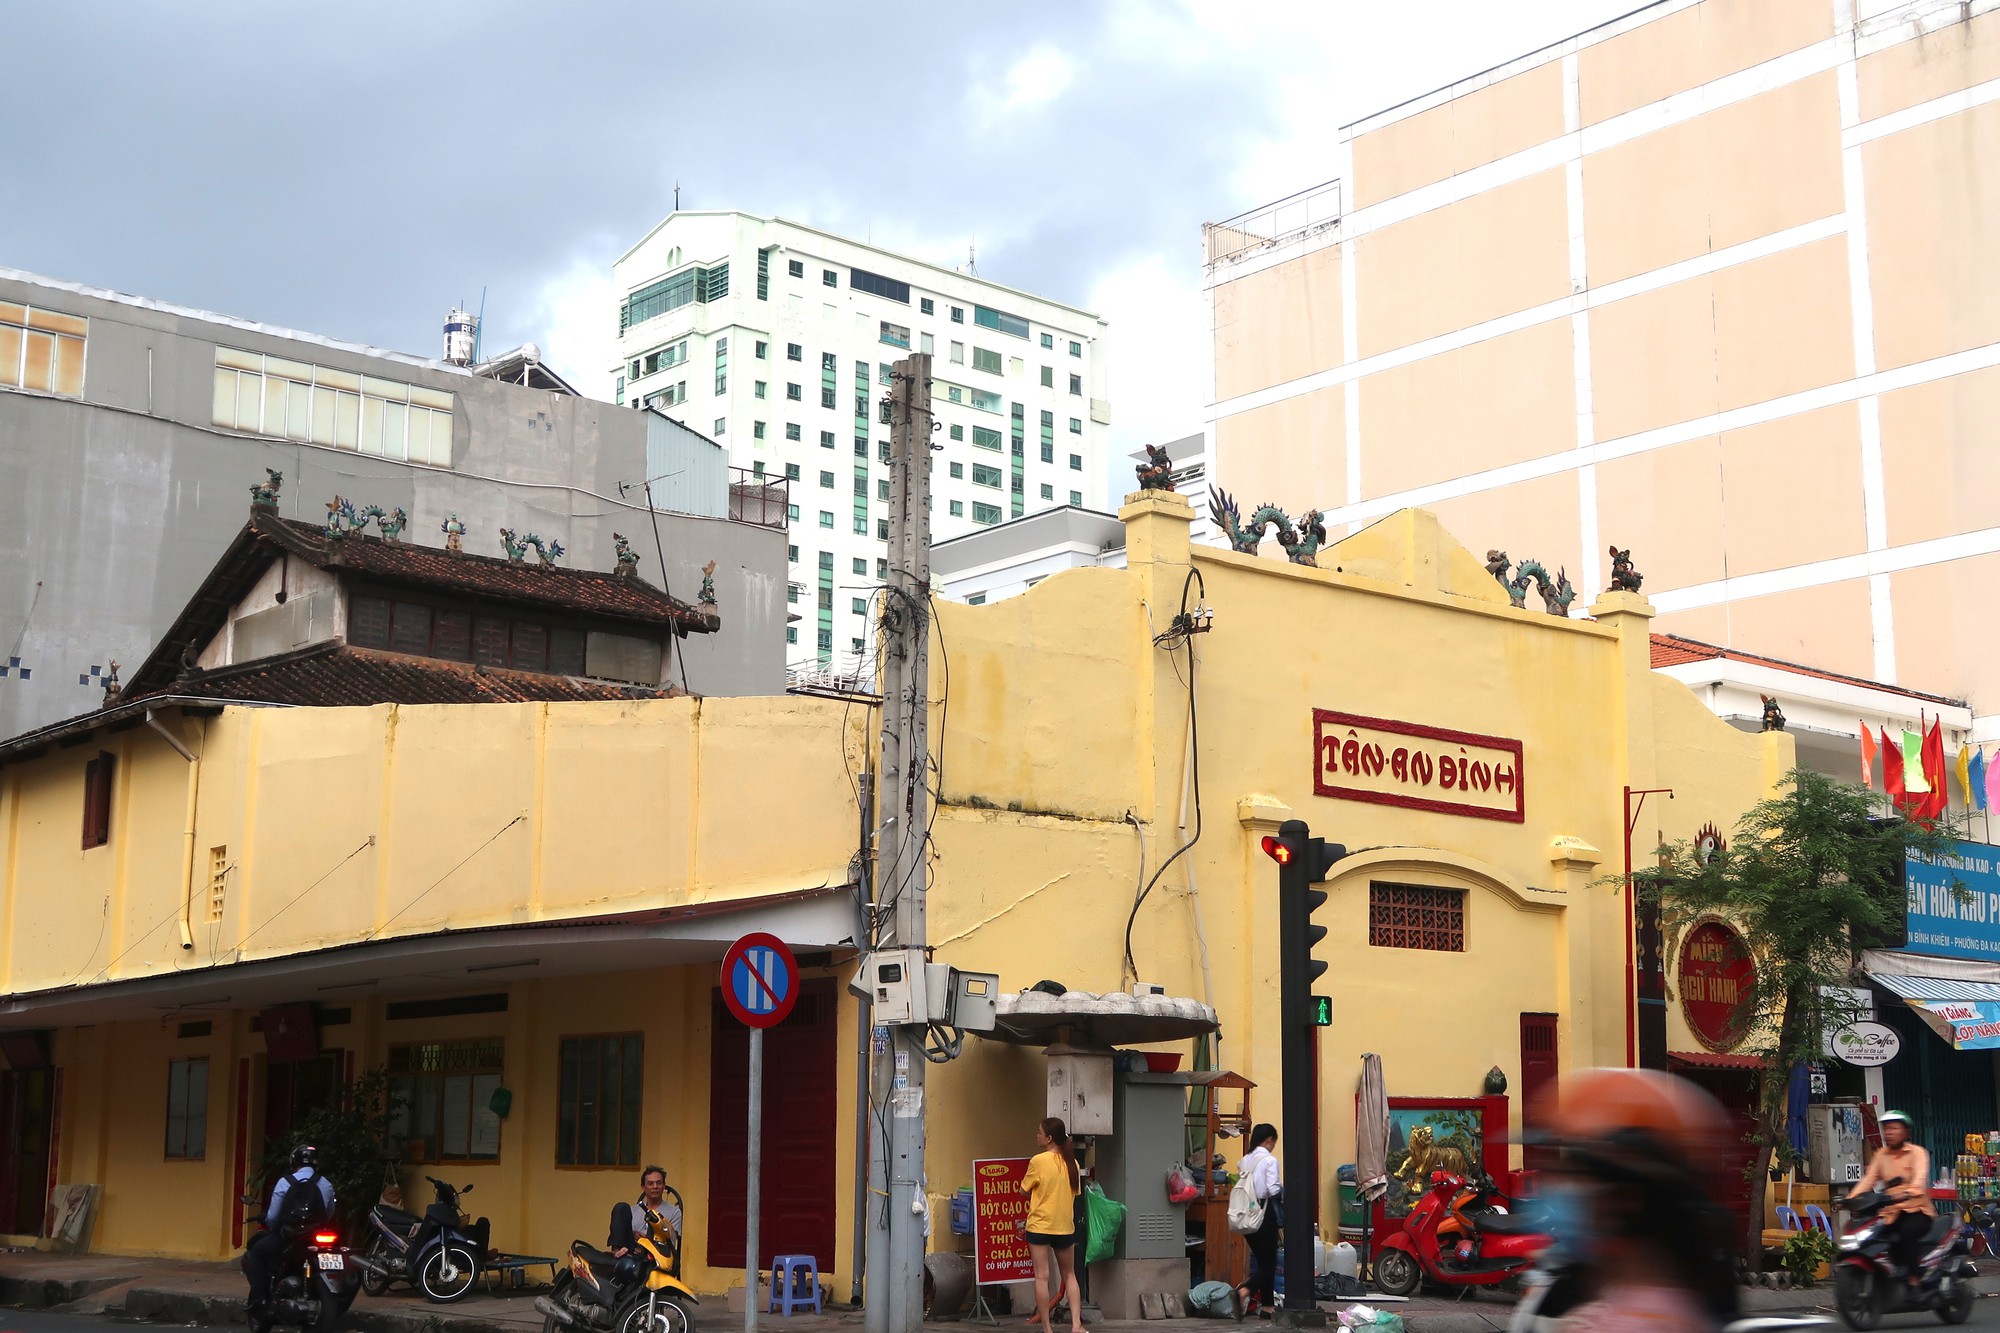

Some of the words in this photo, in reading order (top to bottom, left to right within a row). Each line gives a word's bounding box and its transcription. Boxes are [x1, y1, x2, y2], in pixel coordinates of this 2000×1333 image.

[1439, 747, 1514, 794] ĐÌNH
[1976, 859, 1989, 874] KAO
[1930, 880, 1957, 920] HÓA
[1846, 1165, 1860, 1180] BNE
[983, 1178, 1010, 1195] BÁNH
[980, 1199, 999, 1219] BỘT
[1002, 1201, 1022, 1218] GẠO
[989, 1220, 1013, 1232] TÔM
[990, 1234, 1015, 1246] THỊT
[990, 1245, 1013, 1260] CHẢ
[1016, 1246, 1030, 1258] CÁ
[985, 1260, 995, 1270] CÓ
[997, 1260, 1011, 1270] HỘP
[1013, 1260, 1033, 1268] MANG
